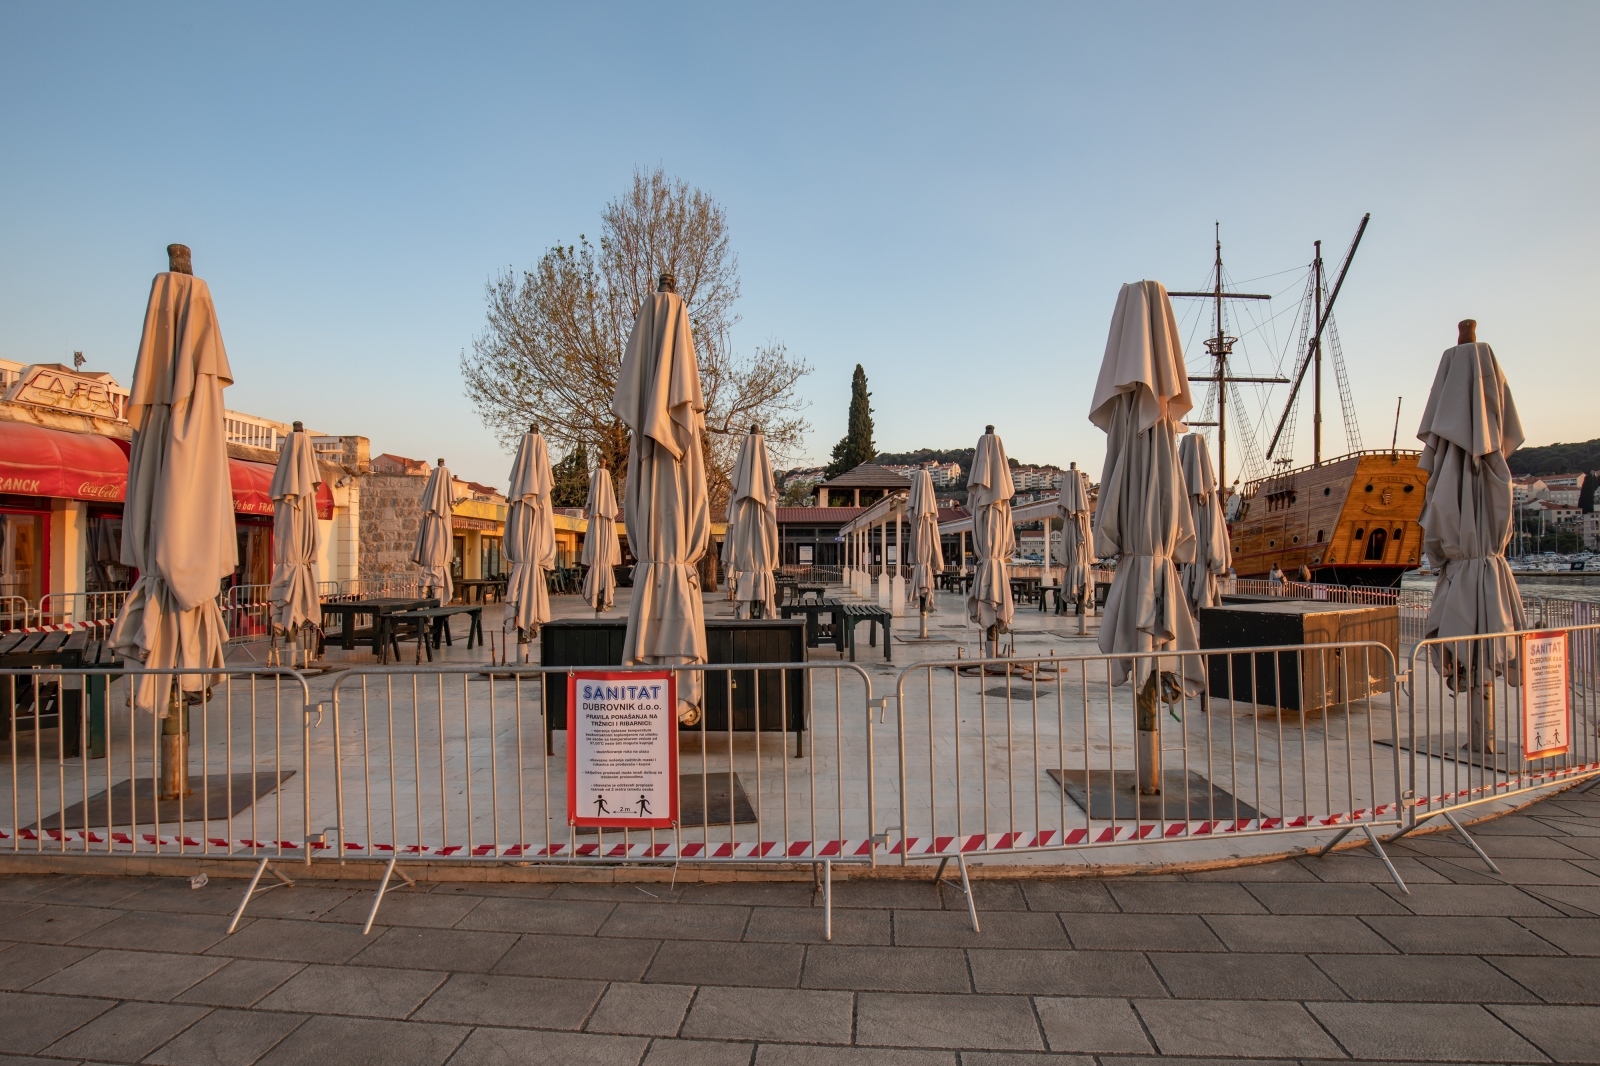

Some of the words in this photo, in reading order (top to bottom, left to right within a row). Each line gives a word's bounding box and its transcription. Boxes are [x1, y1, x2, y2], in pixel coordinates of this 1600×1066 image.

[31, 373, 108, 403] CAFE
[242, 501, 255, 510] bar
[1530, 642, 1561, 656] SANITAT
[583, 685, 662, 700] SANITAT
[583, 702, 635, 711] DUBROVNIK
